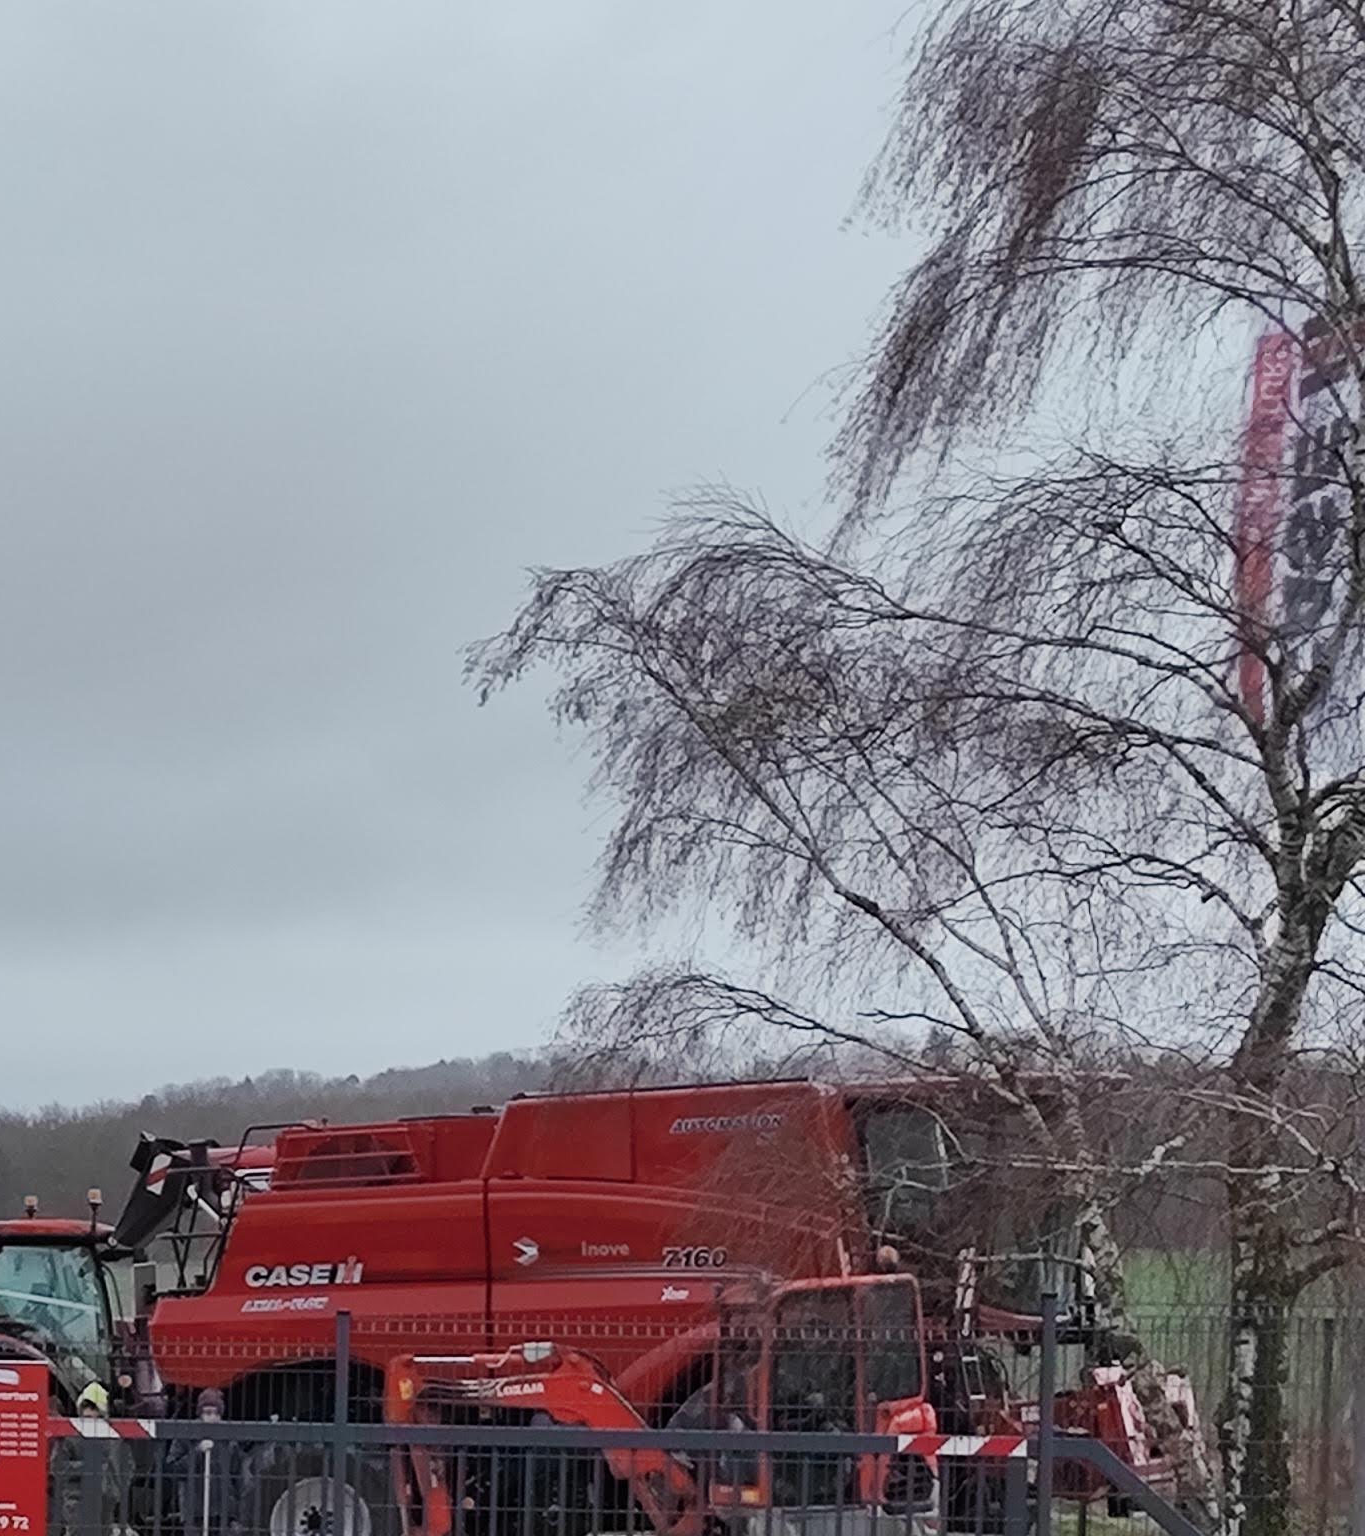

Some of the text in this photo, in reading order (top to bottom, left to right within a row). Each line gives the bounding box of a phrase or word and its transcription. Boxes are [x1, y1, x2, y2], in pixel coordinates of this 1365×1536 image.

[581, 1240, 630, 1257] Inove
[662, 1245, 728, 1268] 7160
[245, 1263, 332, 1288] CASE
[11, 1515, 29, 1530] 72
